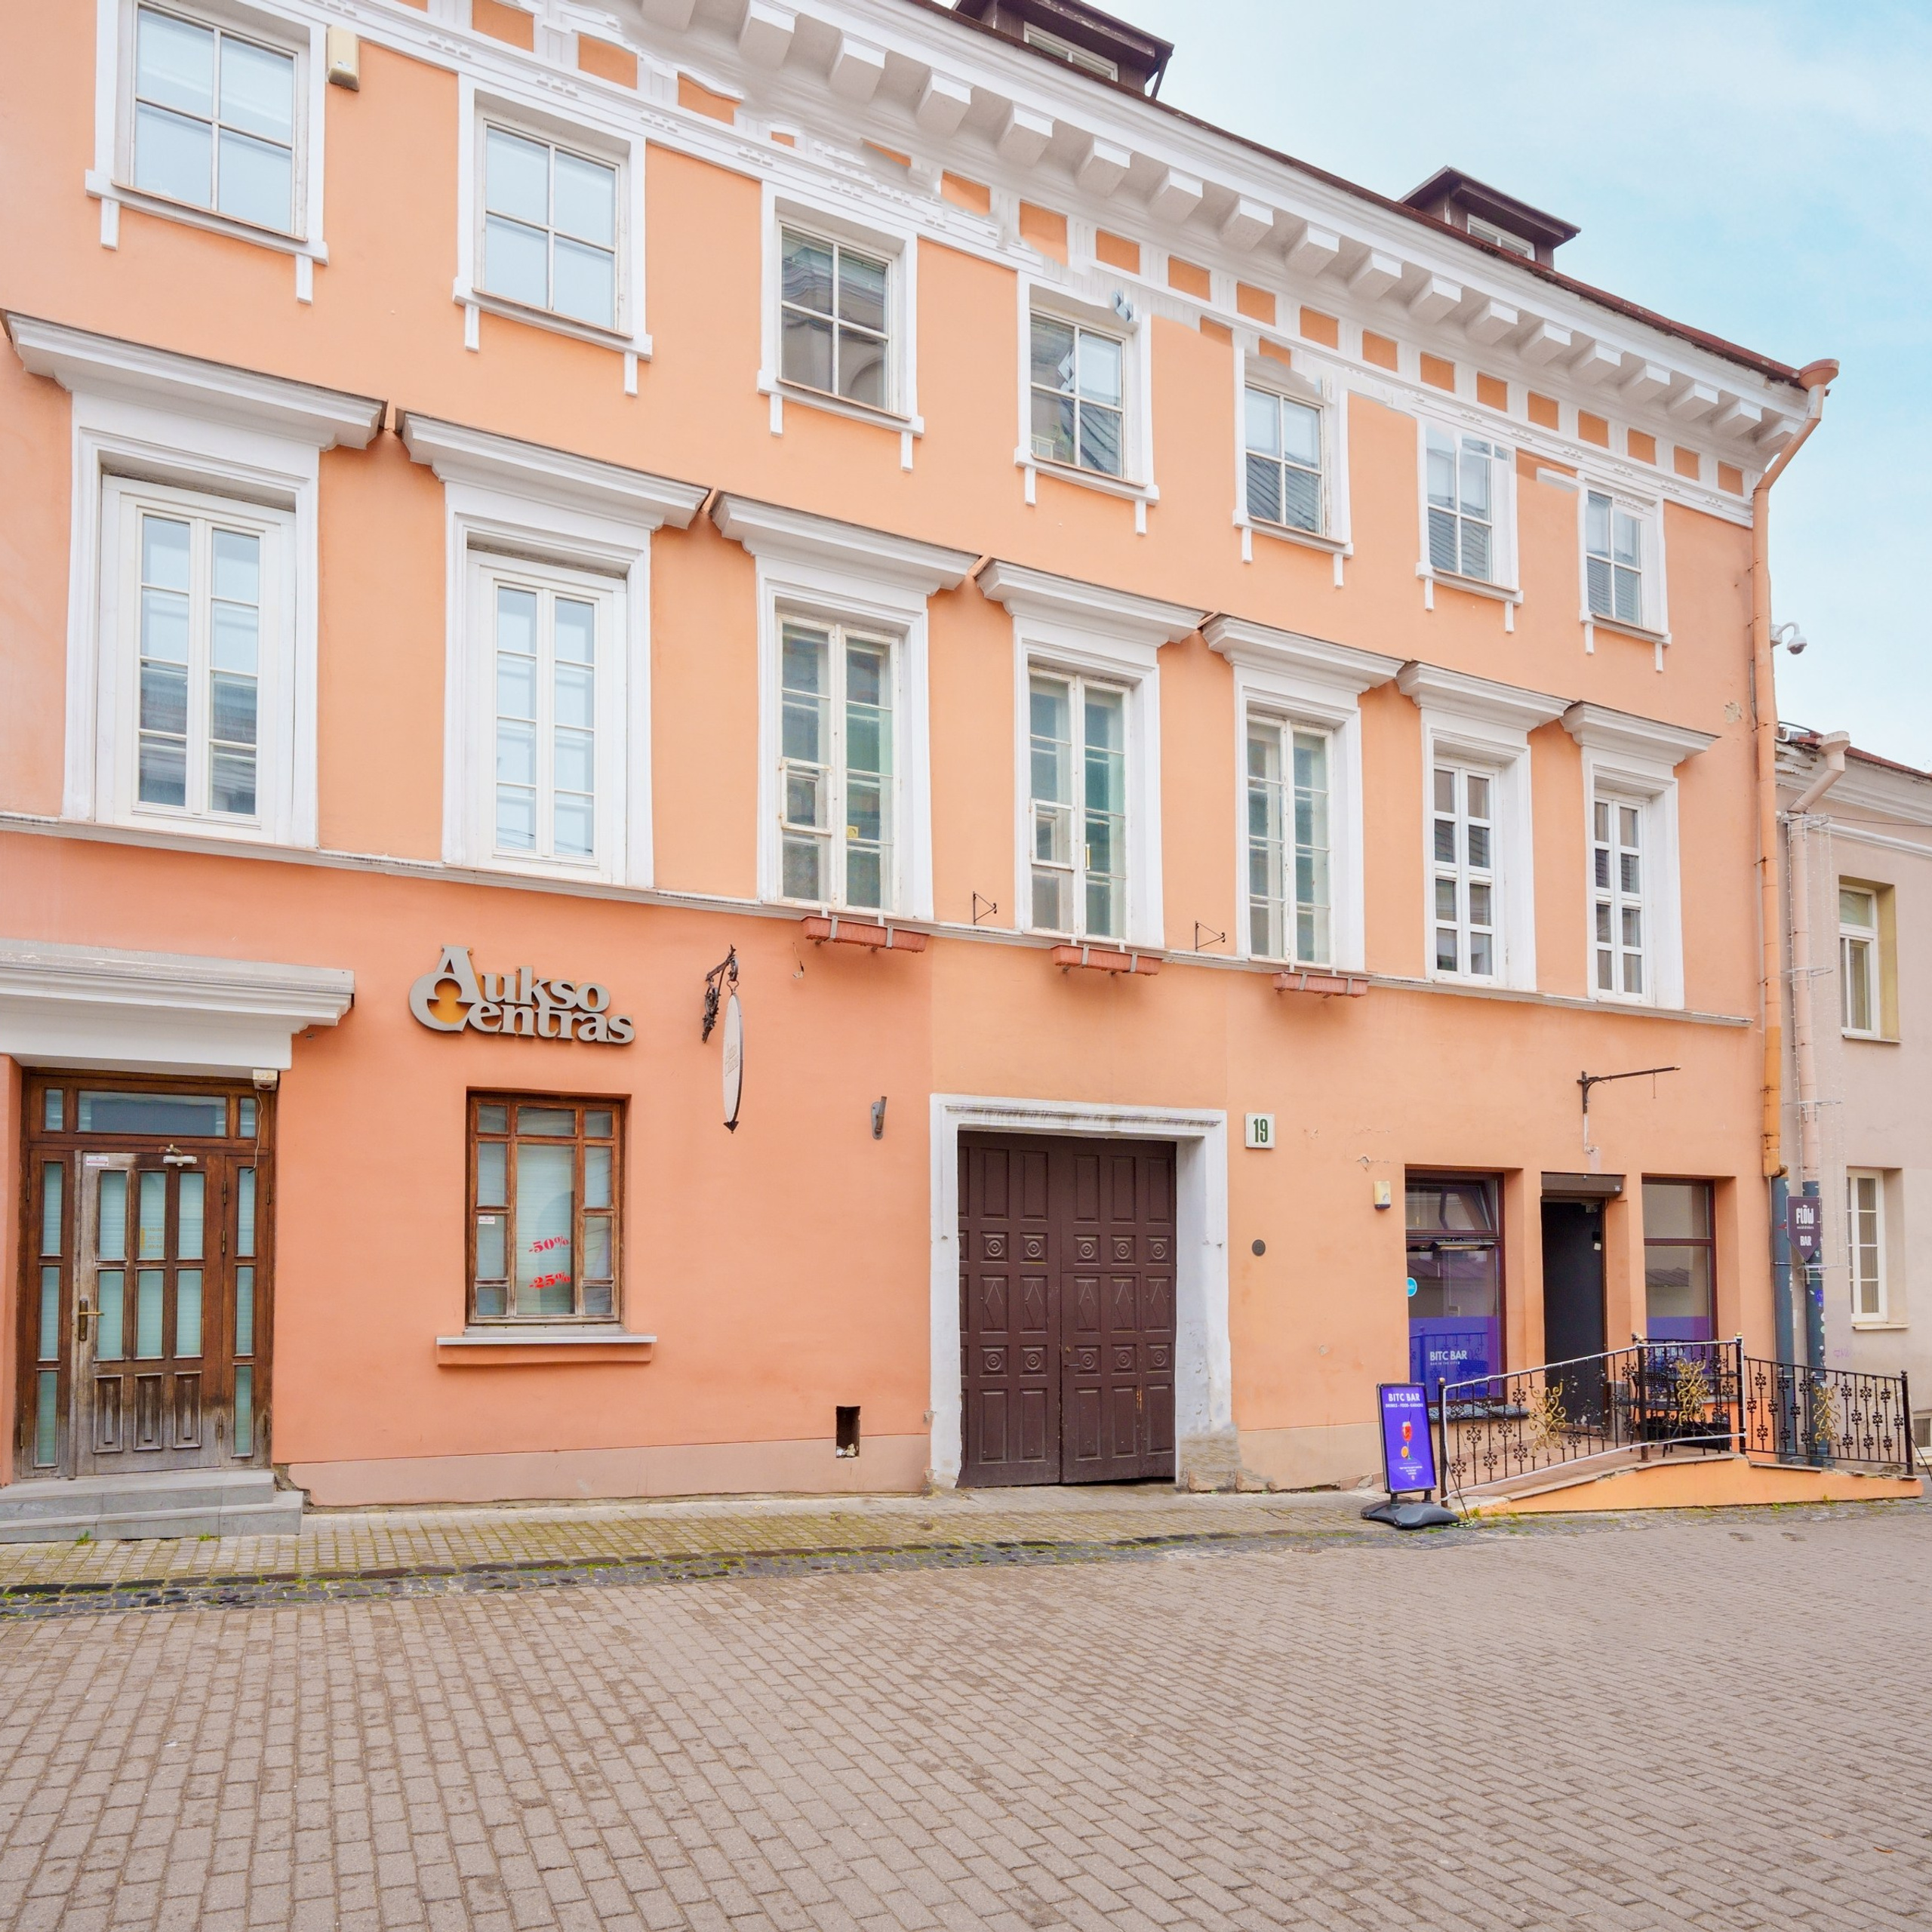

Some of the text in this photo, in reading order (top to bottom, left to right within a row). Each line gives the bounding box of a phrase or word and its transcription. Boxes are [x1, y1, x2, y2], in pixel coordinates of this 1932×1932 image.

[433, 944, 611, 1013] Aukso
[408, 971, 636, 1044] Centras
[1254, 1118, 1268, 1143] 19
[529, 1235, 569, 1253] -50%
[1800, 1235, 1812, 1246] BAR
[529, 1272, 571, 1288] -25%
[1429, 1349, 1468, 1361] BITC BAR
[1388, 1393, 1420, 1402] BITC BAR
